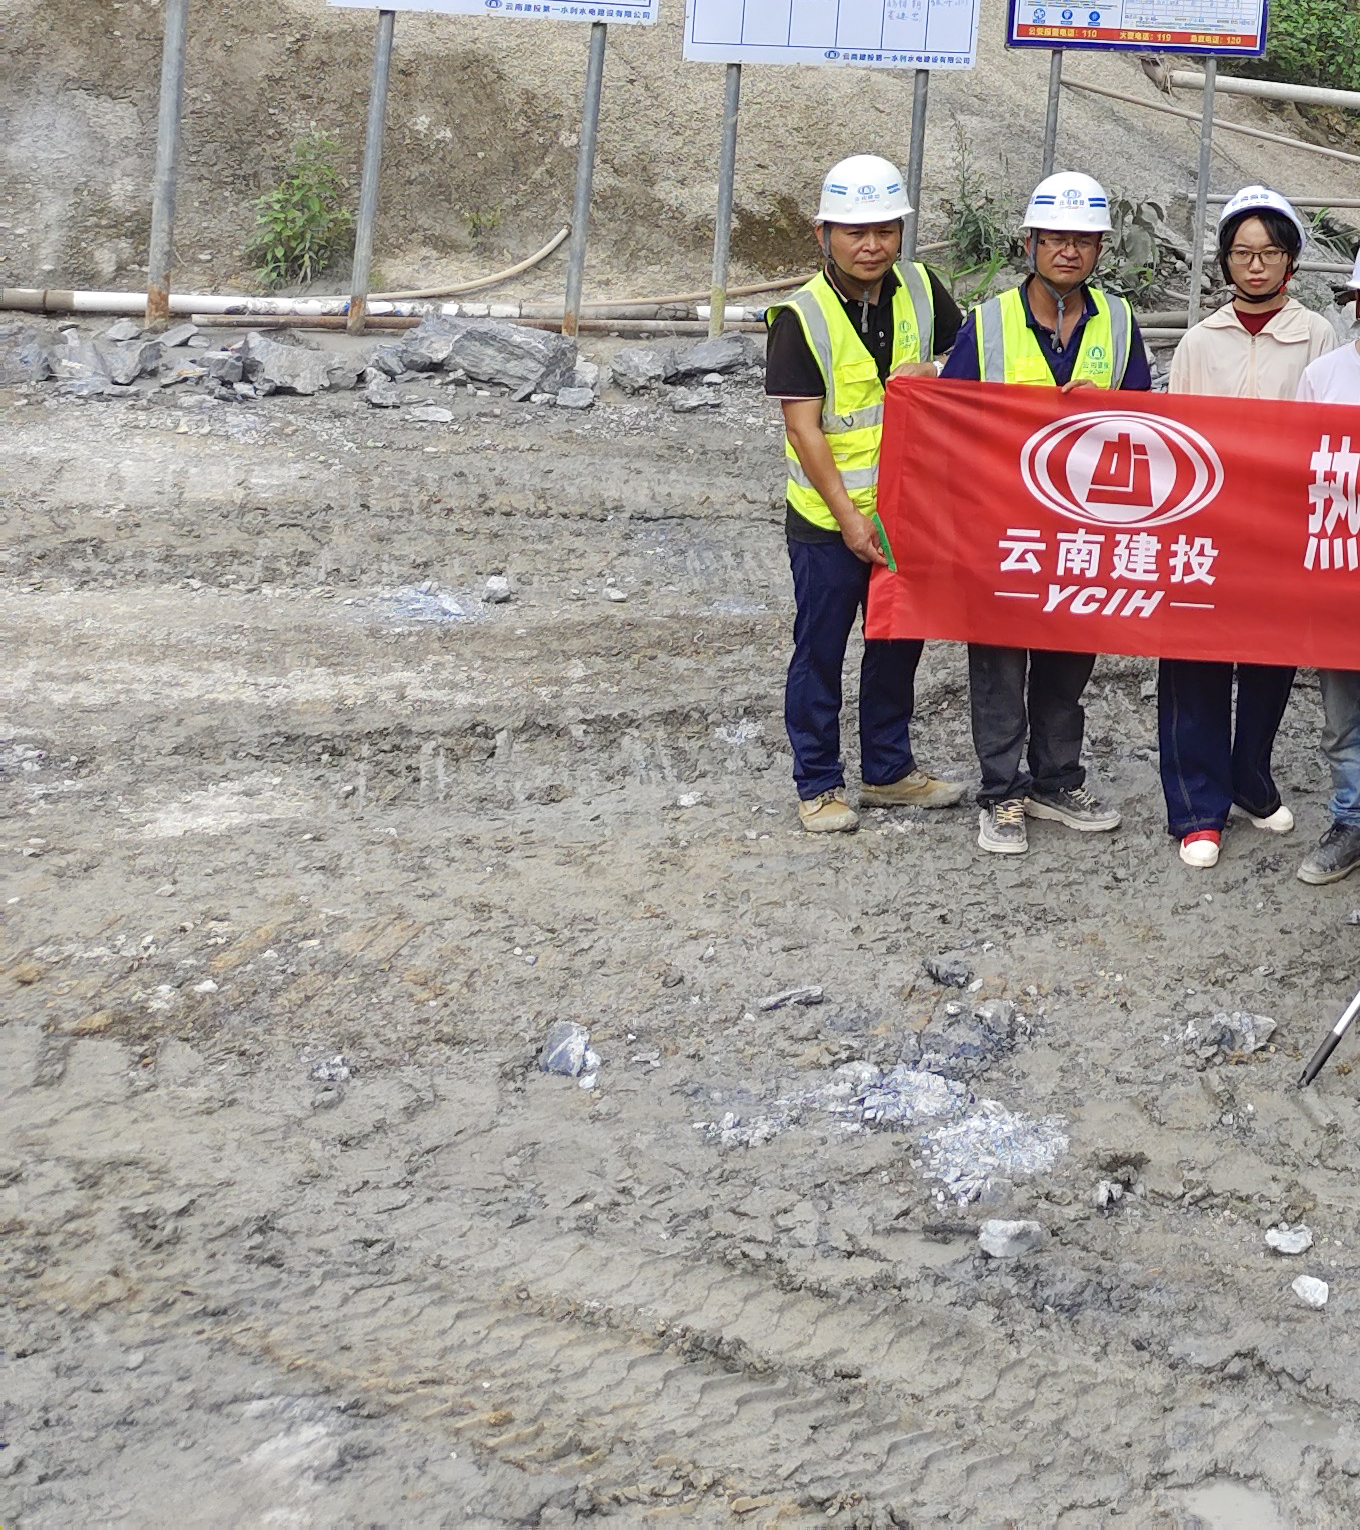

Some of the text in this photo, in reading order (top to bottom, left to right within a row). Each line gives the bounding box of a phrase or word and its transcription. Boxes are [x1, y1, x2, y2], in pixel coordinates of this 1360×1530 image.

[505, 3, 651, 20] 云南建投第一水利水电建设有限公司
[842, 52, 972, 66] 云南建投第一水利水电建设有限公司
[997, 527, 1220, 586] 云南建投
[1041, 584, 1167, 618] YCIH
